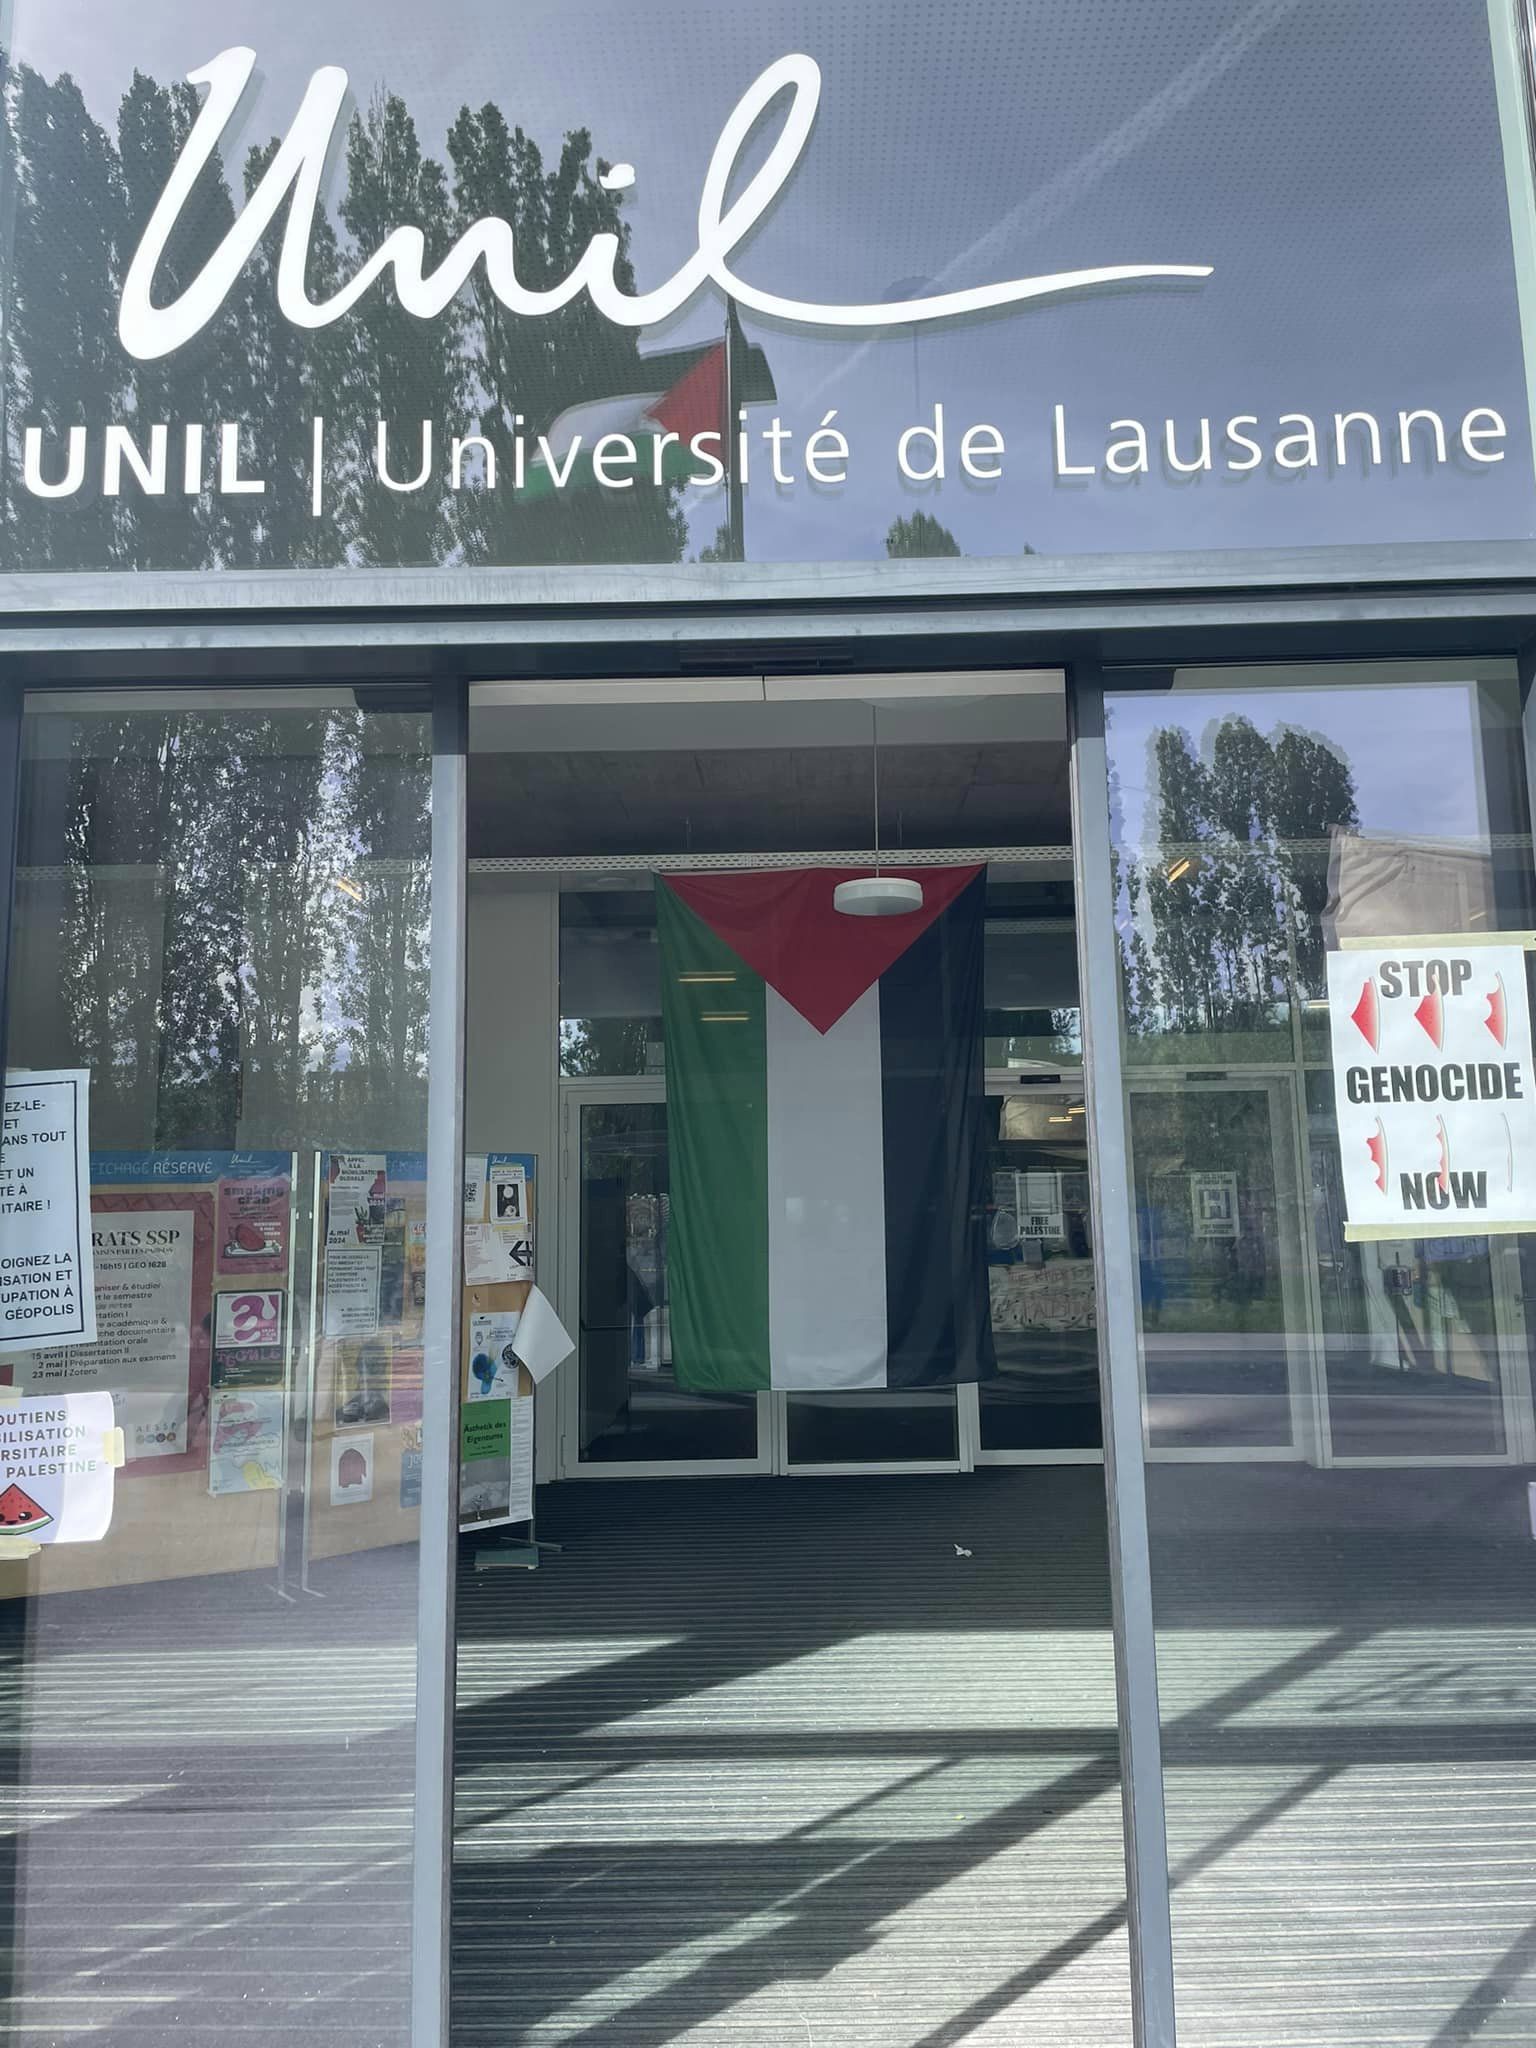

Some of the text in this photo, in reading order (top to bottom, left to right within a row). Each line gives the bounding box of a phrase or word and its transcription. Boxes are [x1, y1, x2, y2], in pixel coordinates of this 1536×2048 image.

[118, 46, 1214, 360] Unil
[23, 424, 265, 498] UNIL
[376, 409, 850, 492] Université
[898, 403, 1005, 480] de
[1054, 404, 1507, 476] Lausanne
[1379, 959, 1472, 999] STOP
[1346, 1062, 1523, 1105] GENOCIDE
[32, 1131, 67, 1143] TOUT
[17, 1168, 34, 1179] UN
[153, 1157, 213, 1175] RÉSERVÉ
[1400, 1170, 1487, 1210] NOW
[145, 1229, 180, 1246] SSP
[1020, 1225, 1061, 1236] PALESTINE
[1, 1253, 73, 1270] OIGNEZ LA
[56, 1269, 73, 1281] ET
[5, 1303, 74, 1321] GÉOPOLIS
[70, 1347, 122, 1358] Dissertation
[46, 1360, 63, 1369] mai
[69, 1356, 121, 1367] Préparation
[45, 1370, 62, 1378] mai
[69, 1367, 98, 1377] Zotero
[6, 1460, 97, 1479] PALESTINE
